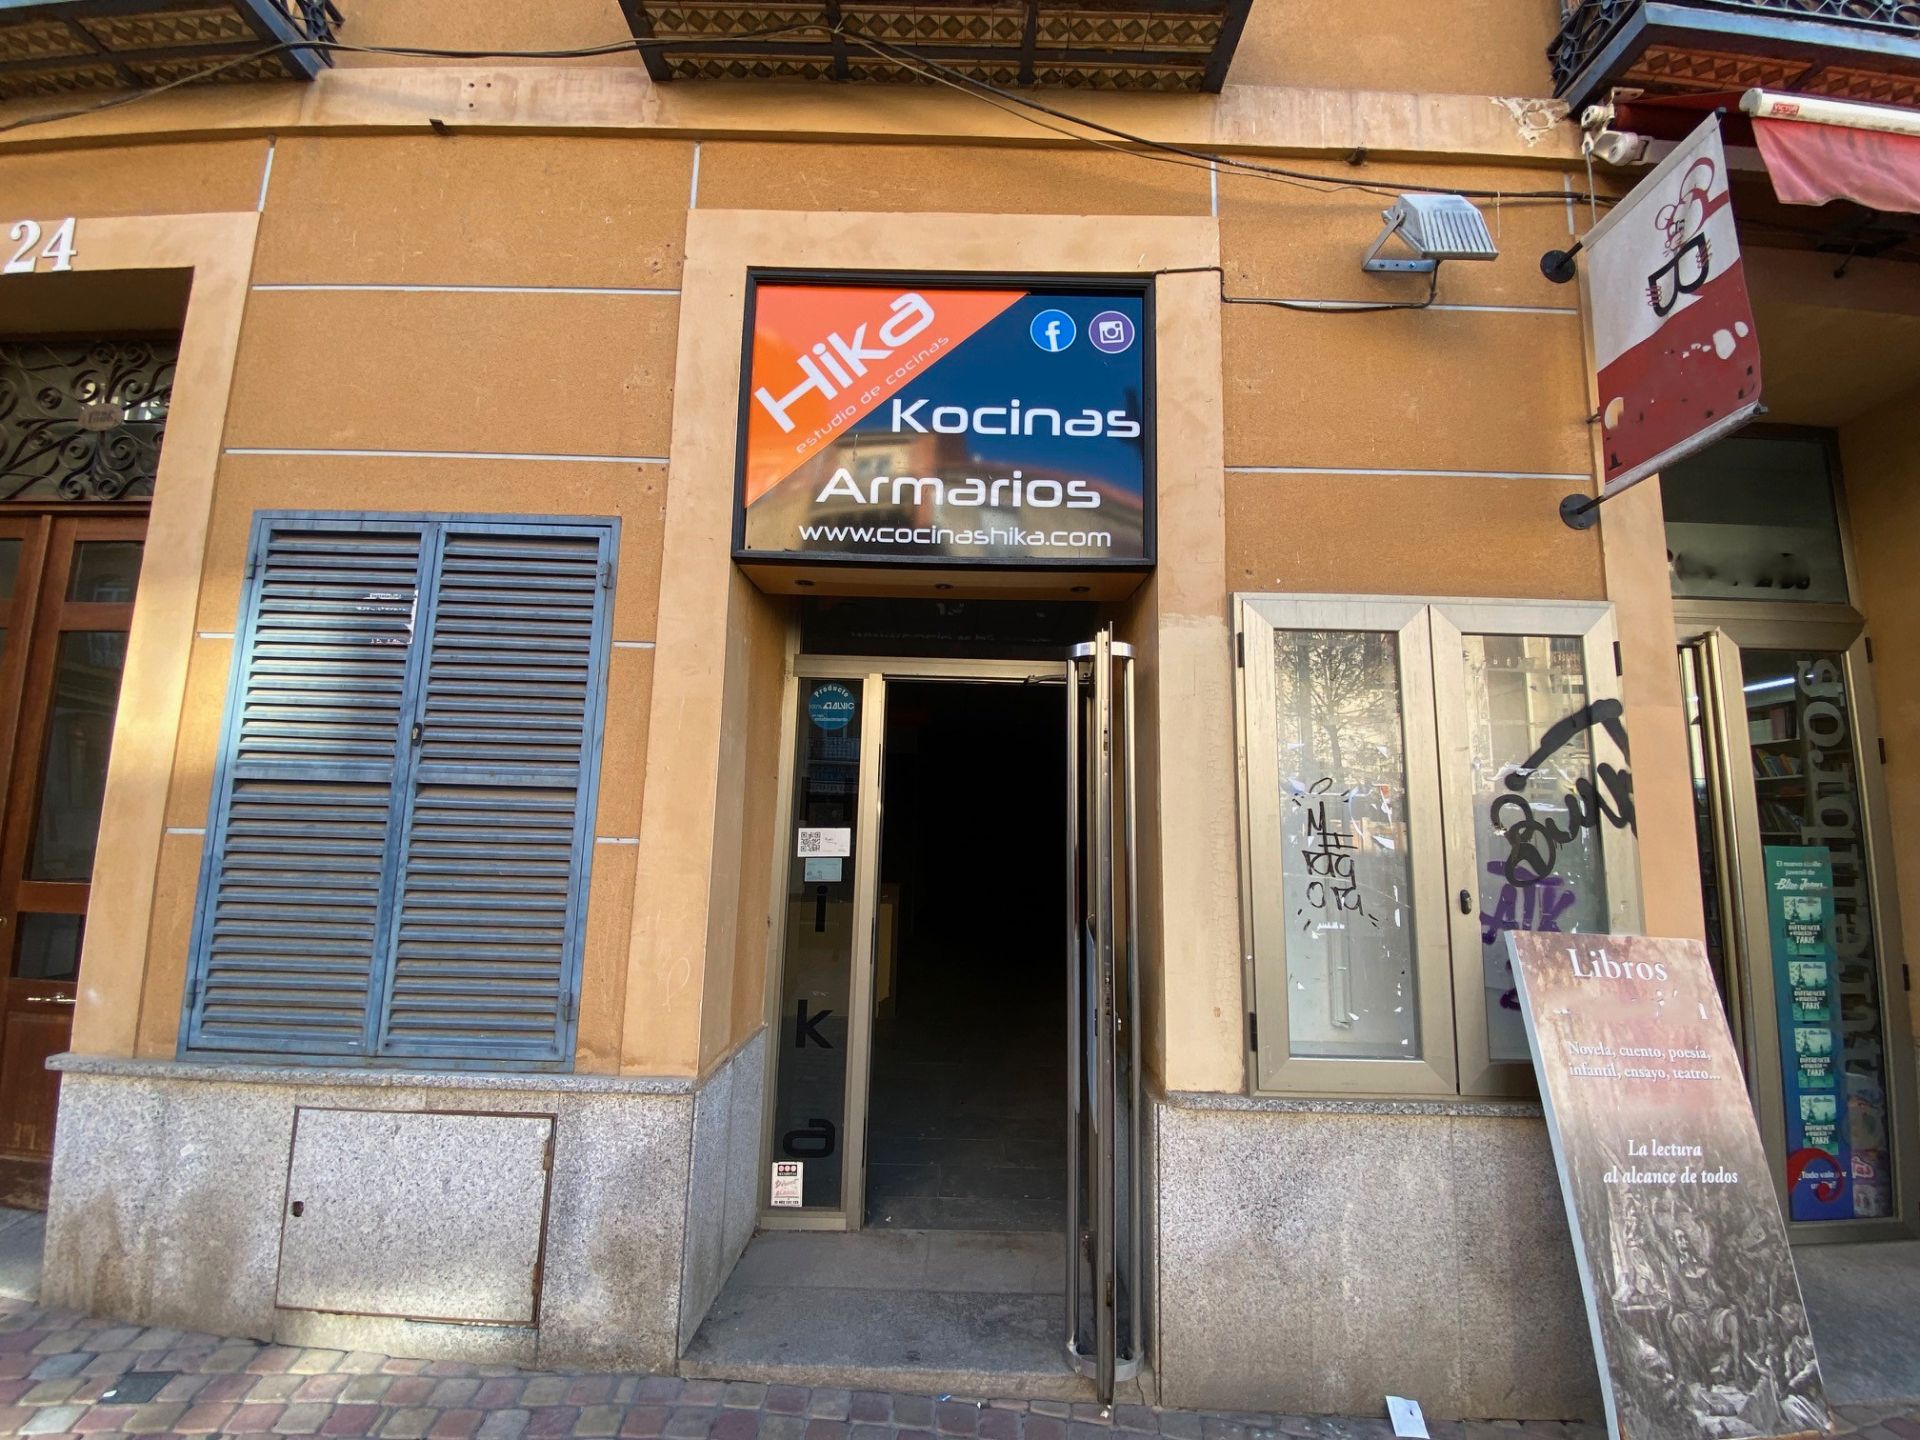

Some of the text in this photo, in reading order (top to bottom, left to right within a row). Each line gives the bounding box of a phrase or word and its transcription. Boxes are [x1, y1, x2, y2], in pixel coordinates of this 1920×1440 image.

[3, 217, 77, 274] 24
[755, 292, 935, 434] Hika
[795, 334, 950, 454] estudio de cocinas
[892, 398, 1141, 438] Kocinas
[815, 467, 1101, 510] Armarios
[798, 525, 1112, 548] www.cocinashika.com
[814, 684, 849, 698] Producto
[1774, 878, 1799, 890] Blue
[1566, 948, 1669, 981] Libros
[1566, 1041, 1712, 1062] Novela, cuento, poesía,
[1568, 1063, 1721, 1082] infantil, ensayo, teatro...
[1628, 1139, 1702, 1156] La lectura
[1603, 1165, 1738, 1183] al alcance de todos
